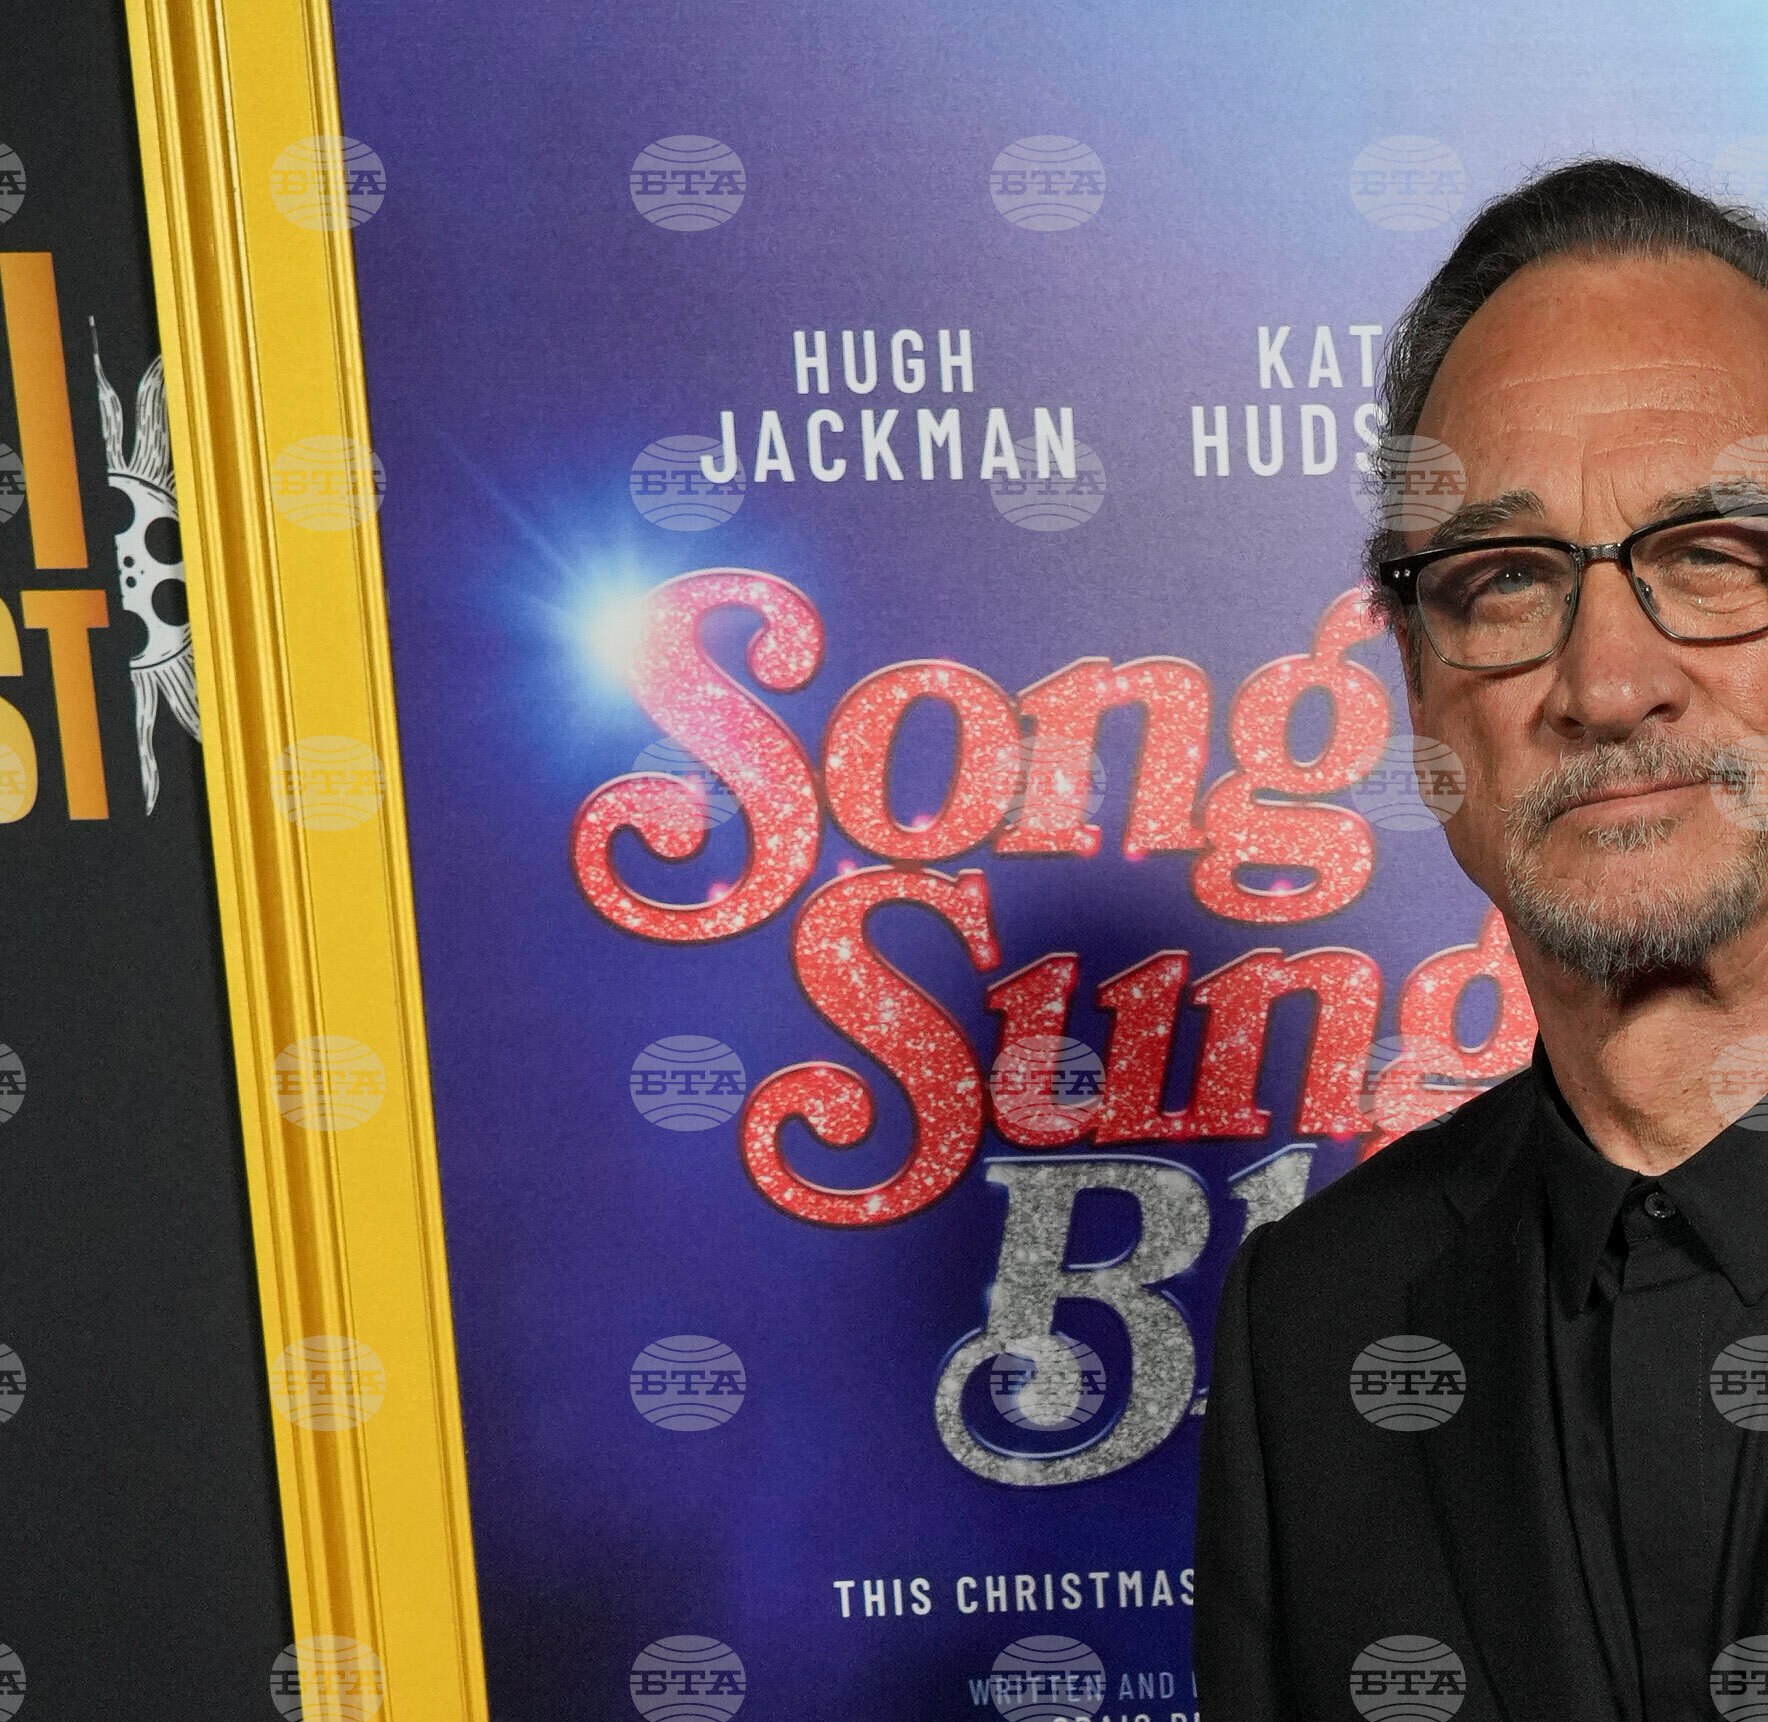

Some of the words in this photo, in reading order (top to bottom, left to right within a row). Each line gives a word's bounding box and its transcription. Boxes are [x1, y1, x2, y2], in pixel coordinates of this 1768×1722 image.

[793, 328, 975, 395] HUGH
[700, 406, 1077, 483] JACKMAN
[570, 568, 1393, 944] Song
[740, 864, 1540, 1228] Sung
[832, 1577, 933, 1618] THIS
[956, 1567, 1195, 1614] CHRISTMAS
[967, 1673, 1105, 1707] WRITTEN
[1118, 1671, 1176, 1701] AND
